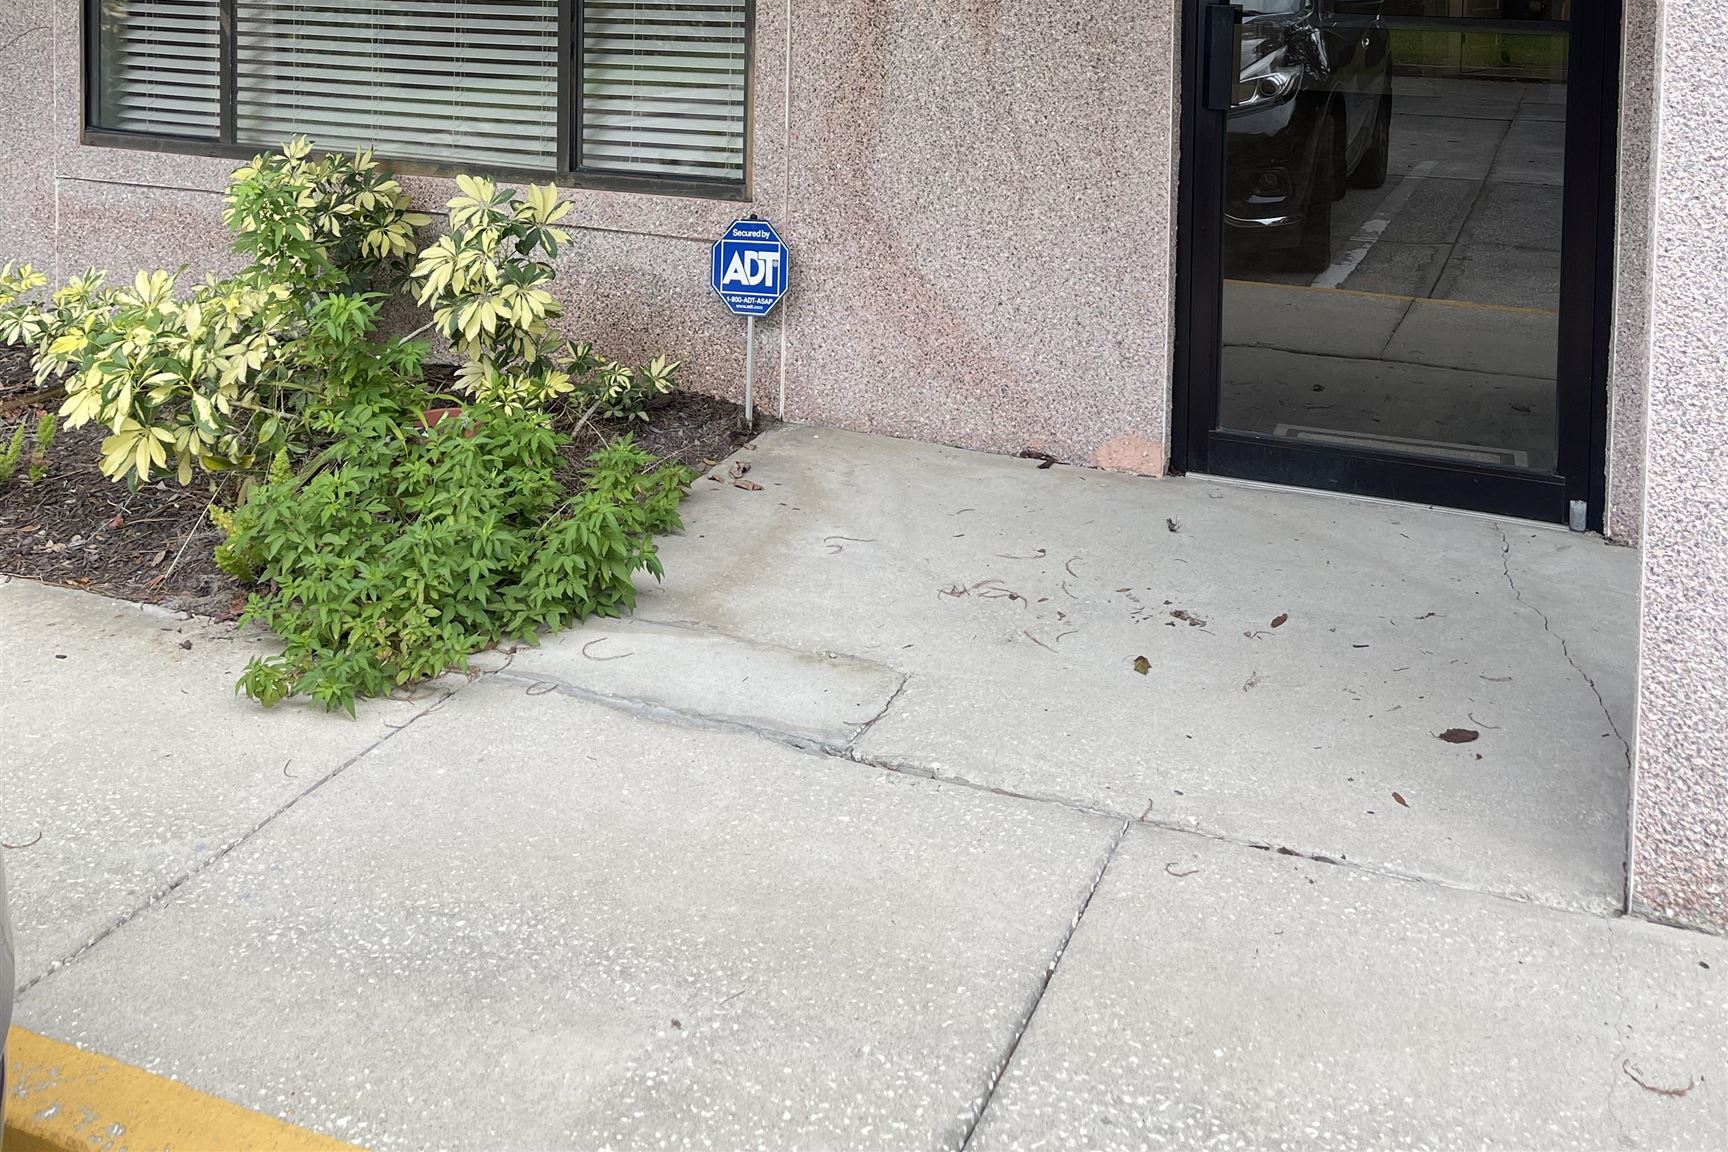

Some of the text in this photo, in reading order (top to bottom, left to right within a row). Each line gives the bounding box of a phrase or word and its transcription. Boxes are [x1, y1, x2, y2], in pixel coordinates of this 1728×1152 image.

[732, 228, 771, 240] Secured by
[722, 250, 779, 287] ADT
[726, 296, 773, 305] 1-800-ADT-ASAP
